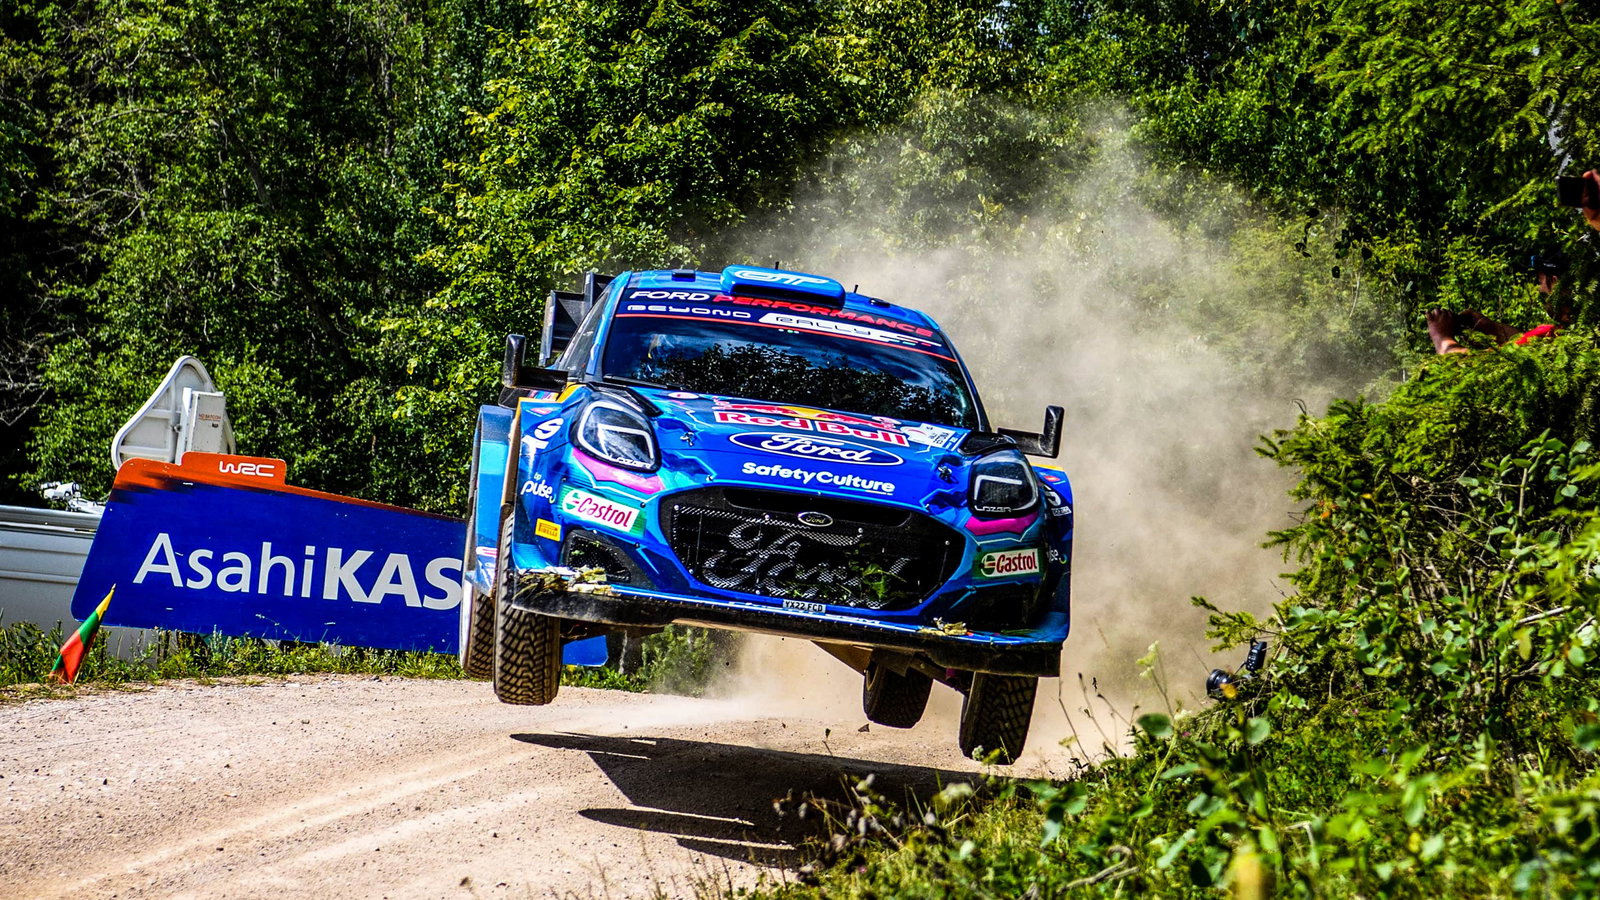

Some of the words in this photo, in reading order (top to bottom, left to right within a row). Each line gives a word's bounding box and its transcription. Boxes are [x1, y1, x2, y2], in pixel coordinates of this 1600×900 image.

[627, 304, 751, 319] BEYOND
[776, 316, 872, 336] RALLY
[629, 290, 710, 301] FORD
[712, 294, 934, 338] PERFORMANCE
[714, 411, 814, 432] Red
[815, 421, 910, 447] Bull
[761, 434, 872, 462] Ford
[219, 460, 275, 477] WRC
[741, 462, 896, 493] SafetyCulture
[520, 480, 553, 499] pulse
[577, 497, 632, 528] Castrol
[132, 532, 463, 610] AsahiKAS
[996, 552, 1038, 573] Castrol
[784, 601, 805, 610] YX22
